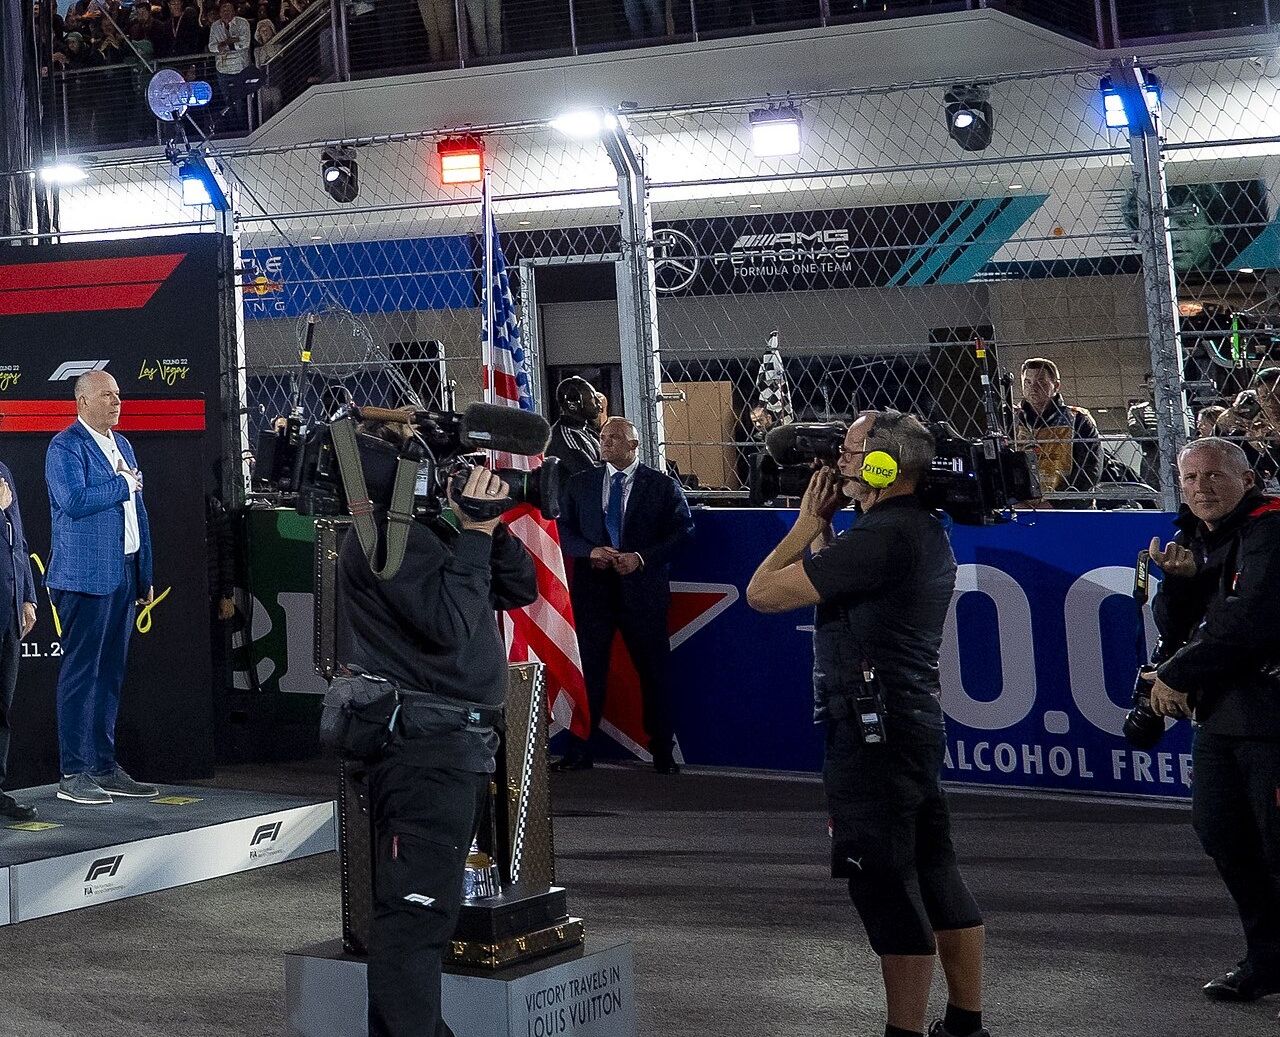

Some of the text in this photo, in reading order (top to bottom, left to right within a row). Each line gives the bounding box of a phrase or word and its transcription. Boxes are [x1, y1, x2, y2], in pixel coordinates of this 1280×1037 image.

[773, 228, 849, 245] AMG
[714, 245, 851, 265] PETRONAS
[734, 262, 852, 277] FORMULA ONE TEAM
[21, 642, 65, 657] 11.2
[943, 740, 1193, 788] ALCOHOL FREE
[524, 966, 620, 1013] VICTORY TRAVELS IN
[527, 988, 623, 1037] LOUIS VUITTON
